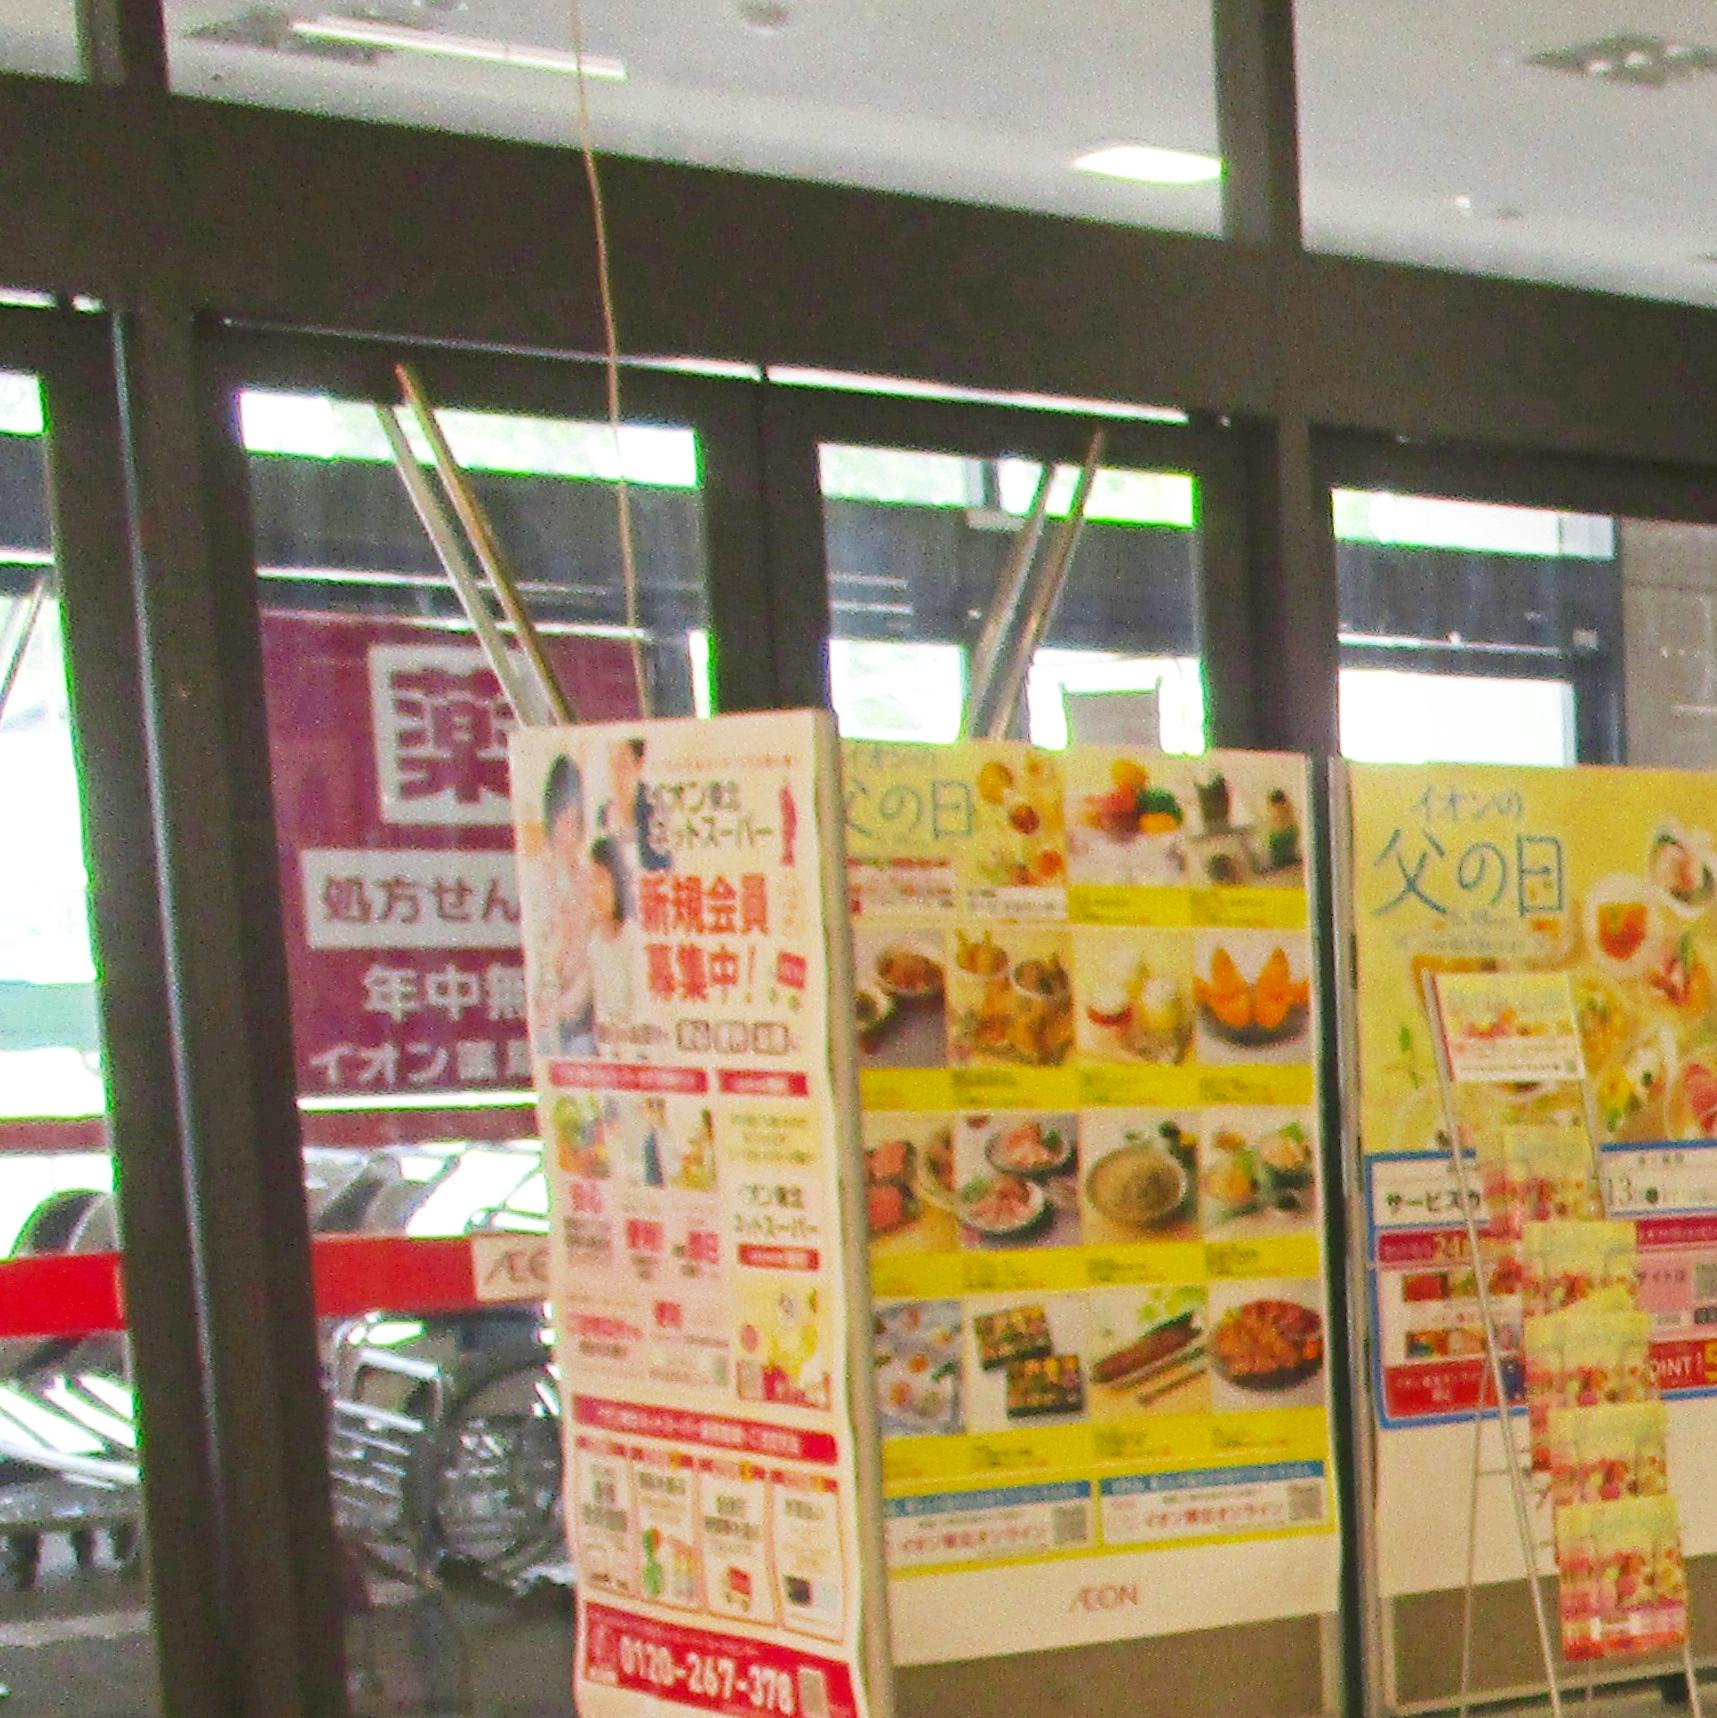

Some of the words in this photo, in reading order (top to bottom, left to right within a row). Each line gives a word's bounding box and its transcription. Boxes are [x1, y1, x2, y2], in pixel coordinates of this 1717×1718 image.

[321, 872, 520, 926] 処方せん
[1374, 827, 1562, 917] 父の日
